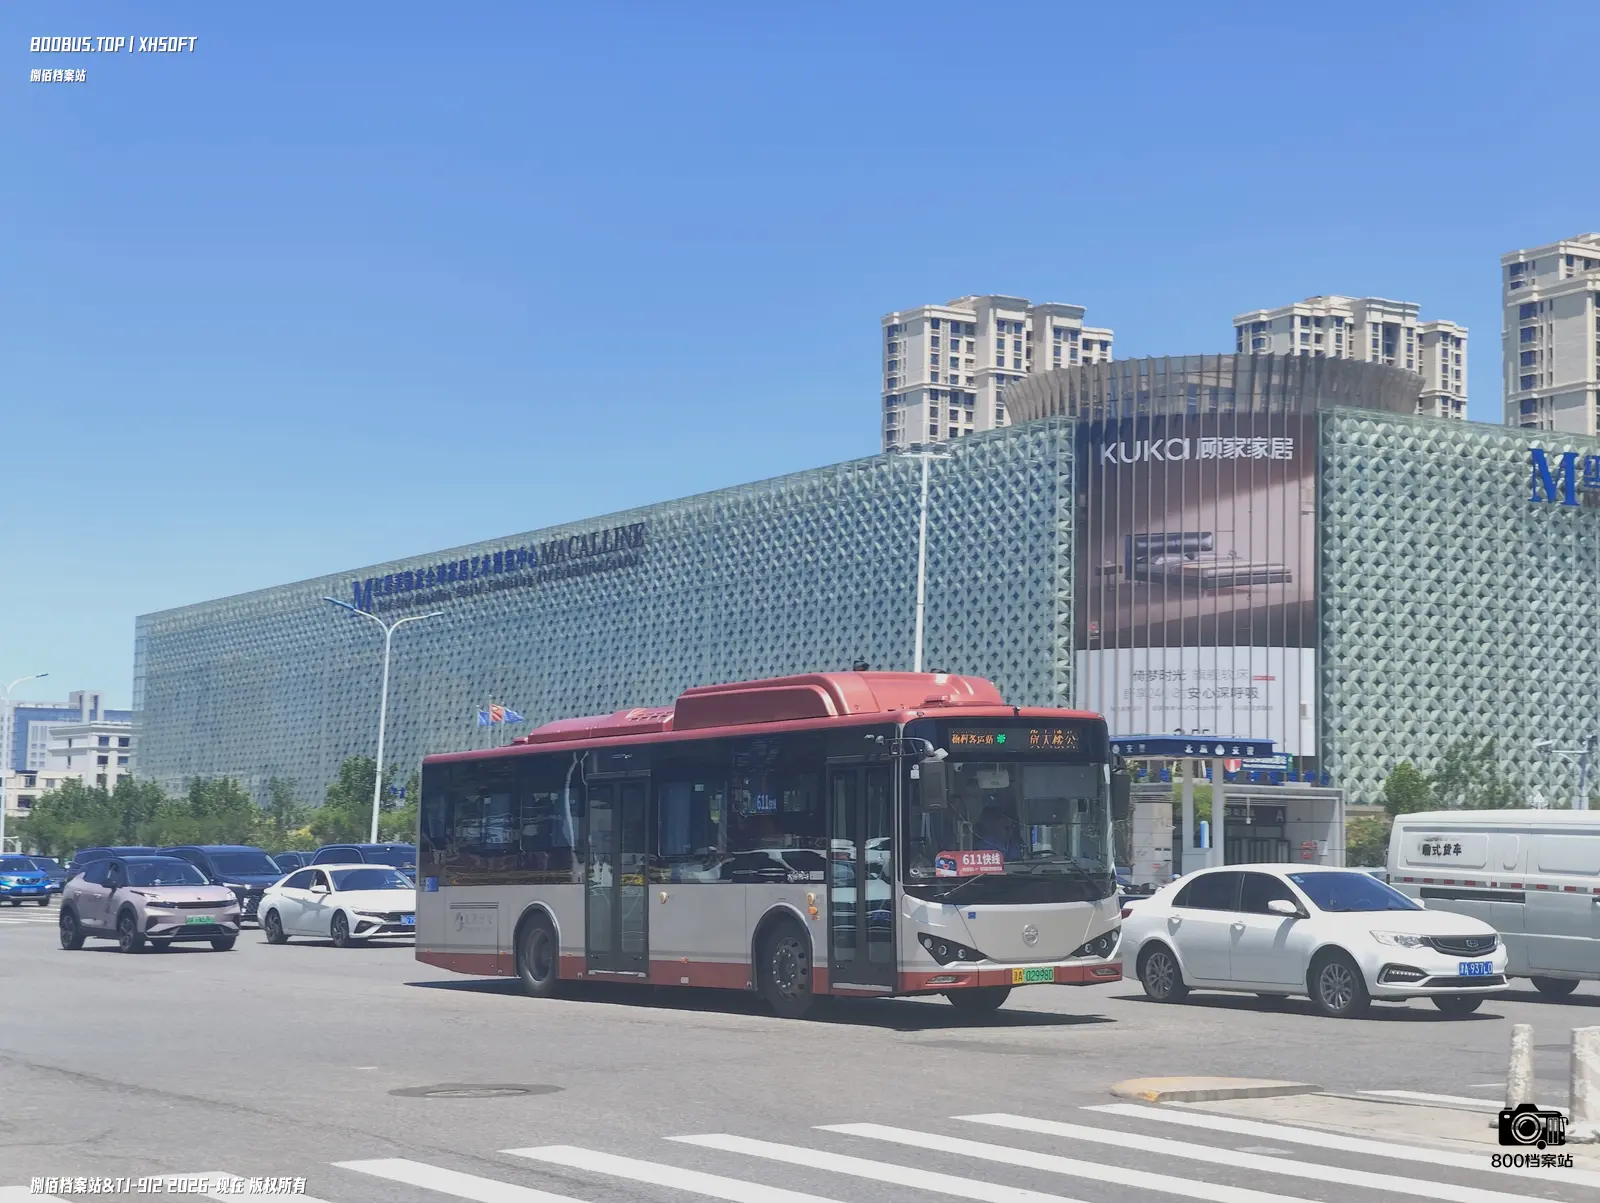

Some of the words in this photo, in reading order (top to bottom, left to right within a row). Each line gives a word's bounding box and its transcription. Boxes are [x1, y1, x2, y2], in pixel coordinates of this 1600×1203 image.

[1196, 436, 1294, 461] 顾家家居
[1528, 448, 1580, 507] M
[962, 853, 1001, 865] 611快线
